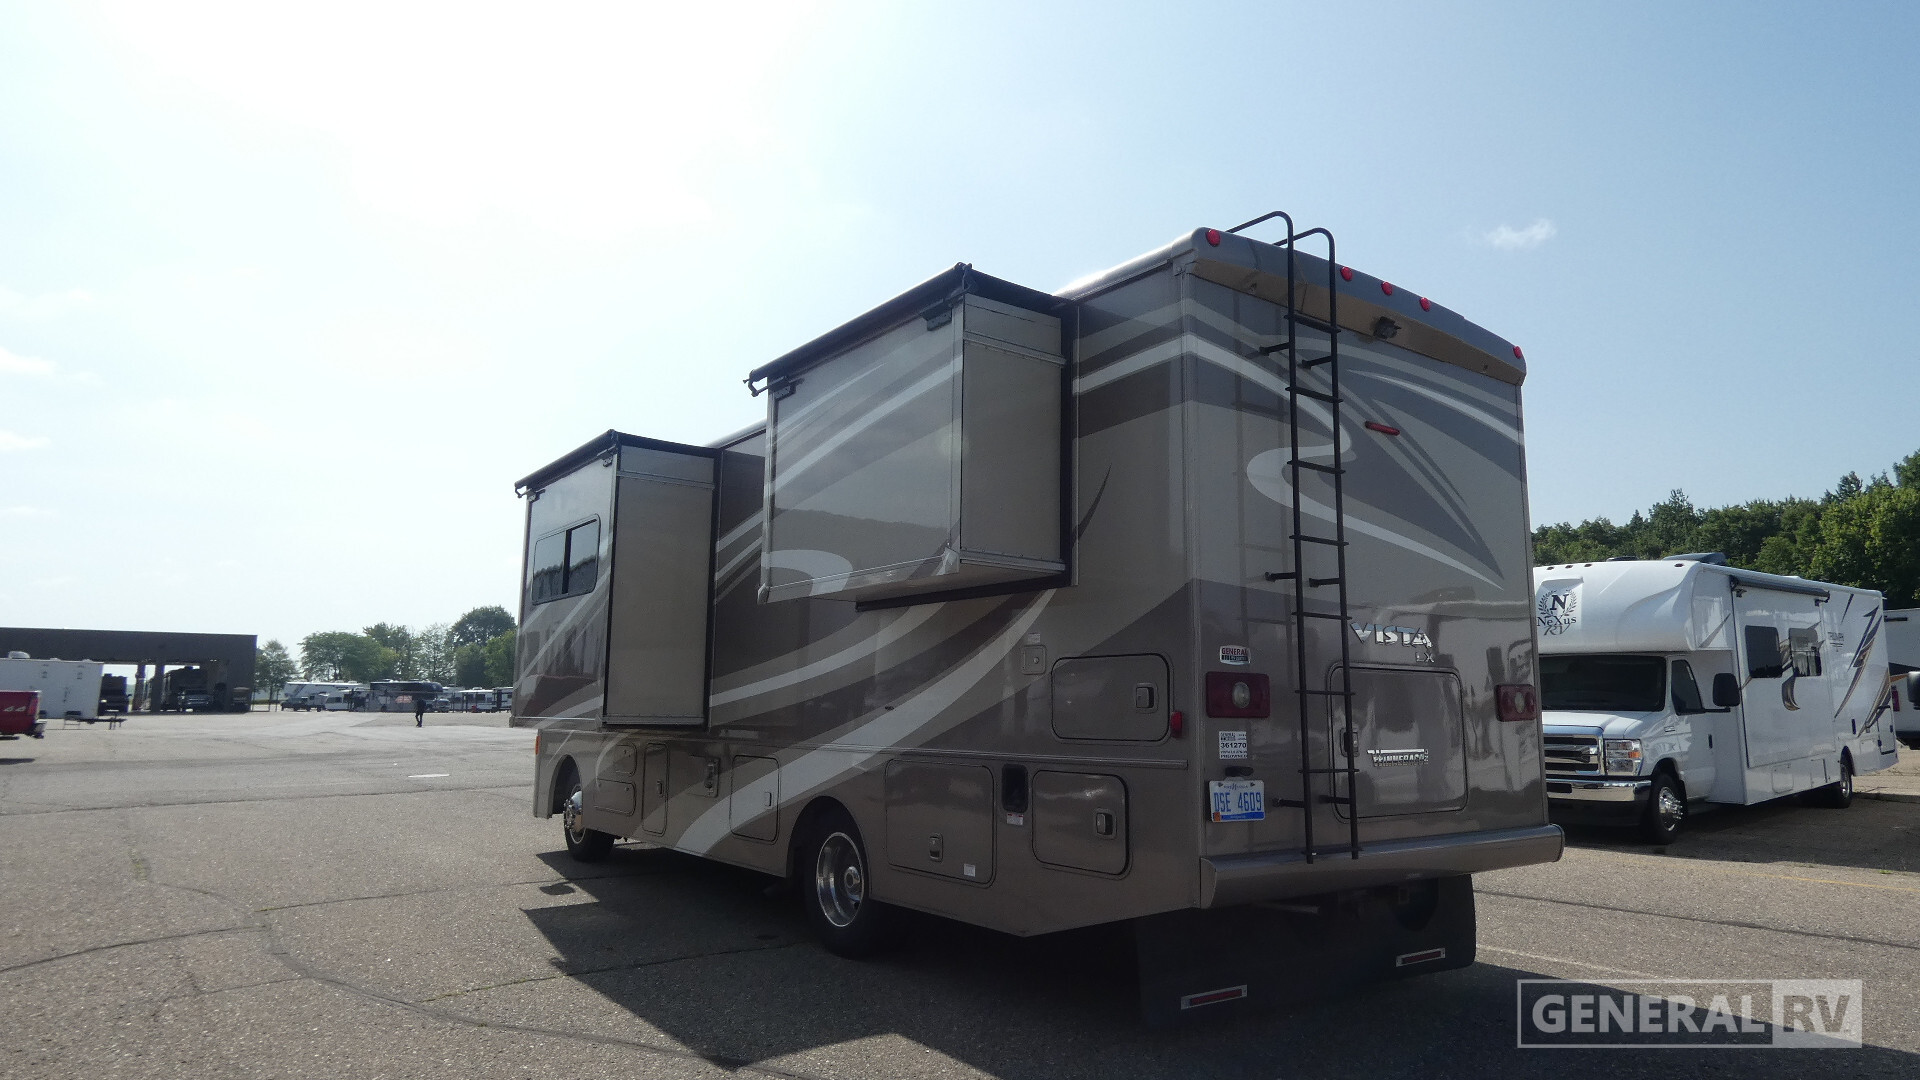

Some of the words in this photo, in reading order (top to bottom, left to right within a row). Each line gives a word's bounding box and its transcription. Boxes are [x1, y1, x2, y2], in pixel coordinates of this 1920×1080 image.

[1549, 594, 1570, 611] N
[1350, 622, 1433, 649] VISTA
[1415, 652, 1435, 663] LX
[1213, 792, 1232, 812] DSE
[1237, 791, 1262, 812] 4609
